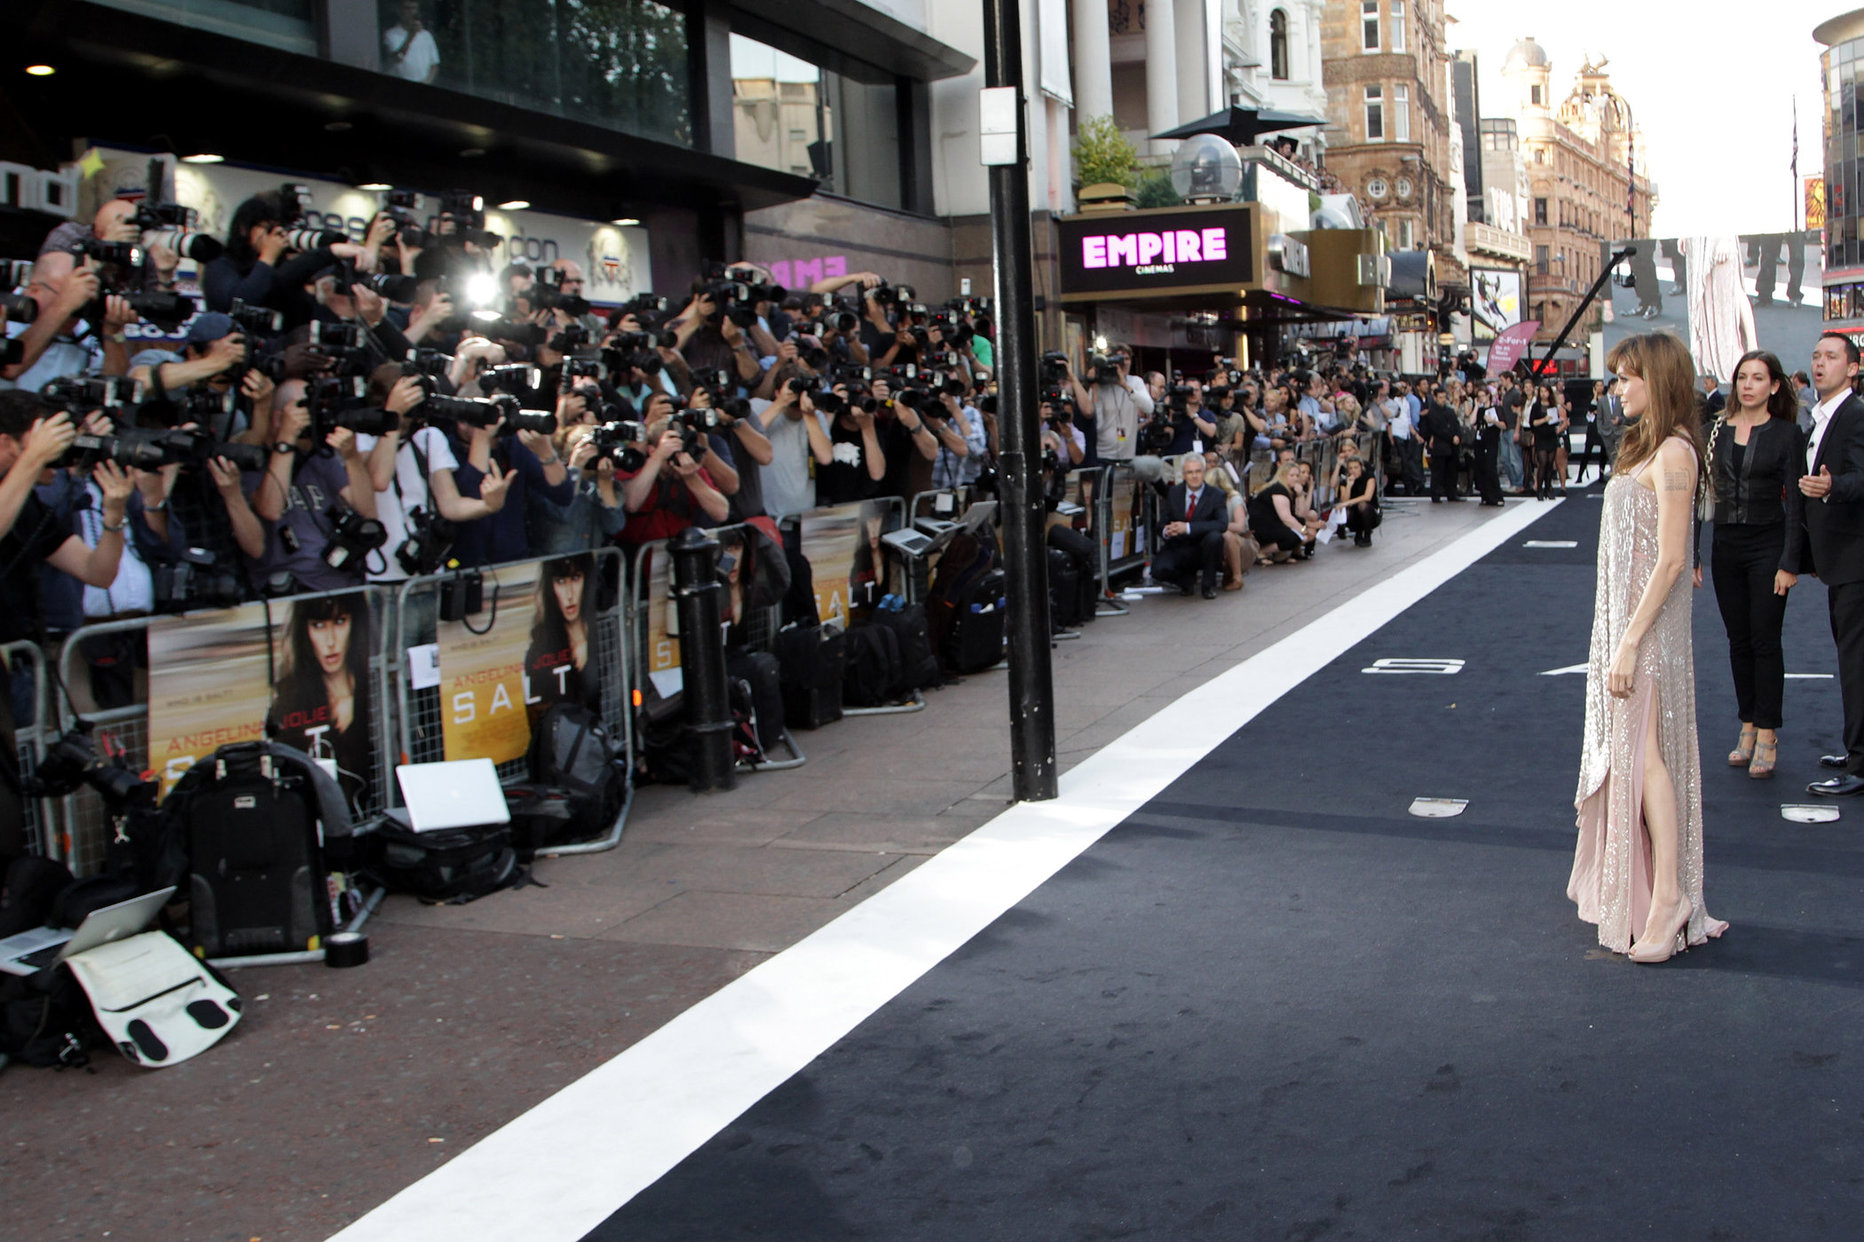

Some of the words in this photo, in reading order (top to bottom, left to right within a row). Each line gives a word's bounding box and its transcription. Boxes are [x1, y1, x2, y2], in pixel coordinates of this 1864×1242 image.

[1082, 227, 1228, 269] EMPIRE
[1135, 264, 1175, 275] CINEMAS
[454, 664, 525, 688] ANGELINA
[532, 650, 571, 670] JOLIE
[452, 664, 572, 725] SALT
[166, 720, 266, 754] ANGELINA
[280, 705, 329, 730] JOLIE
